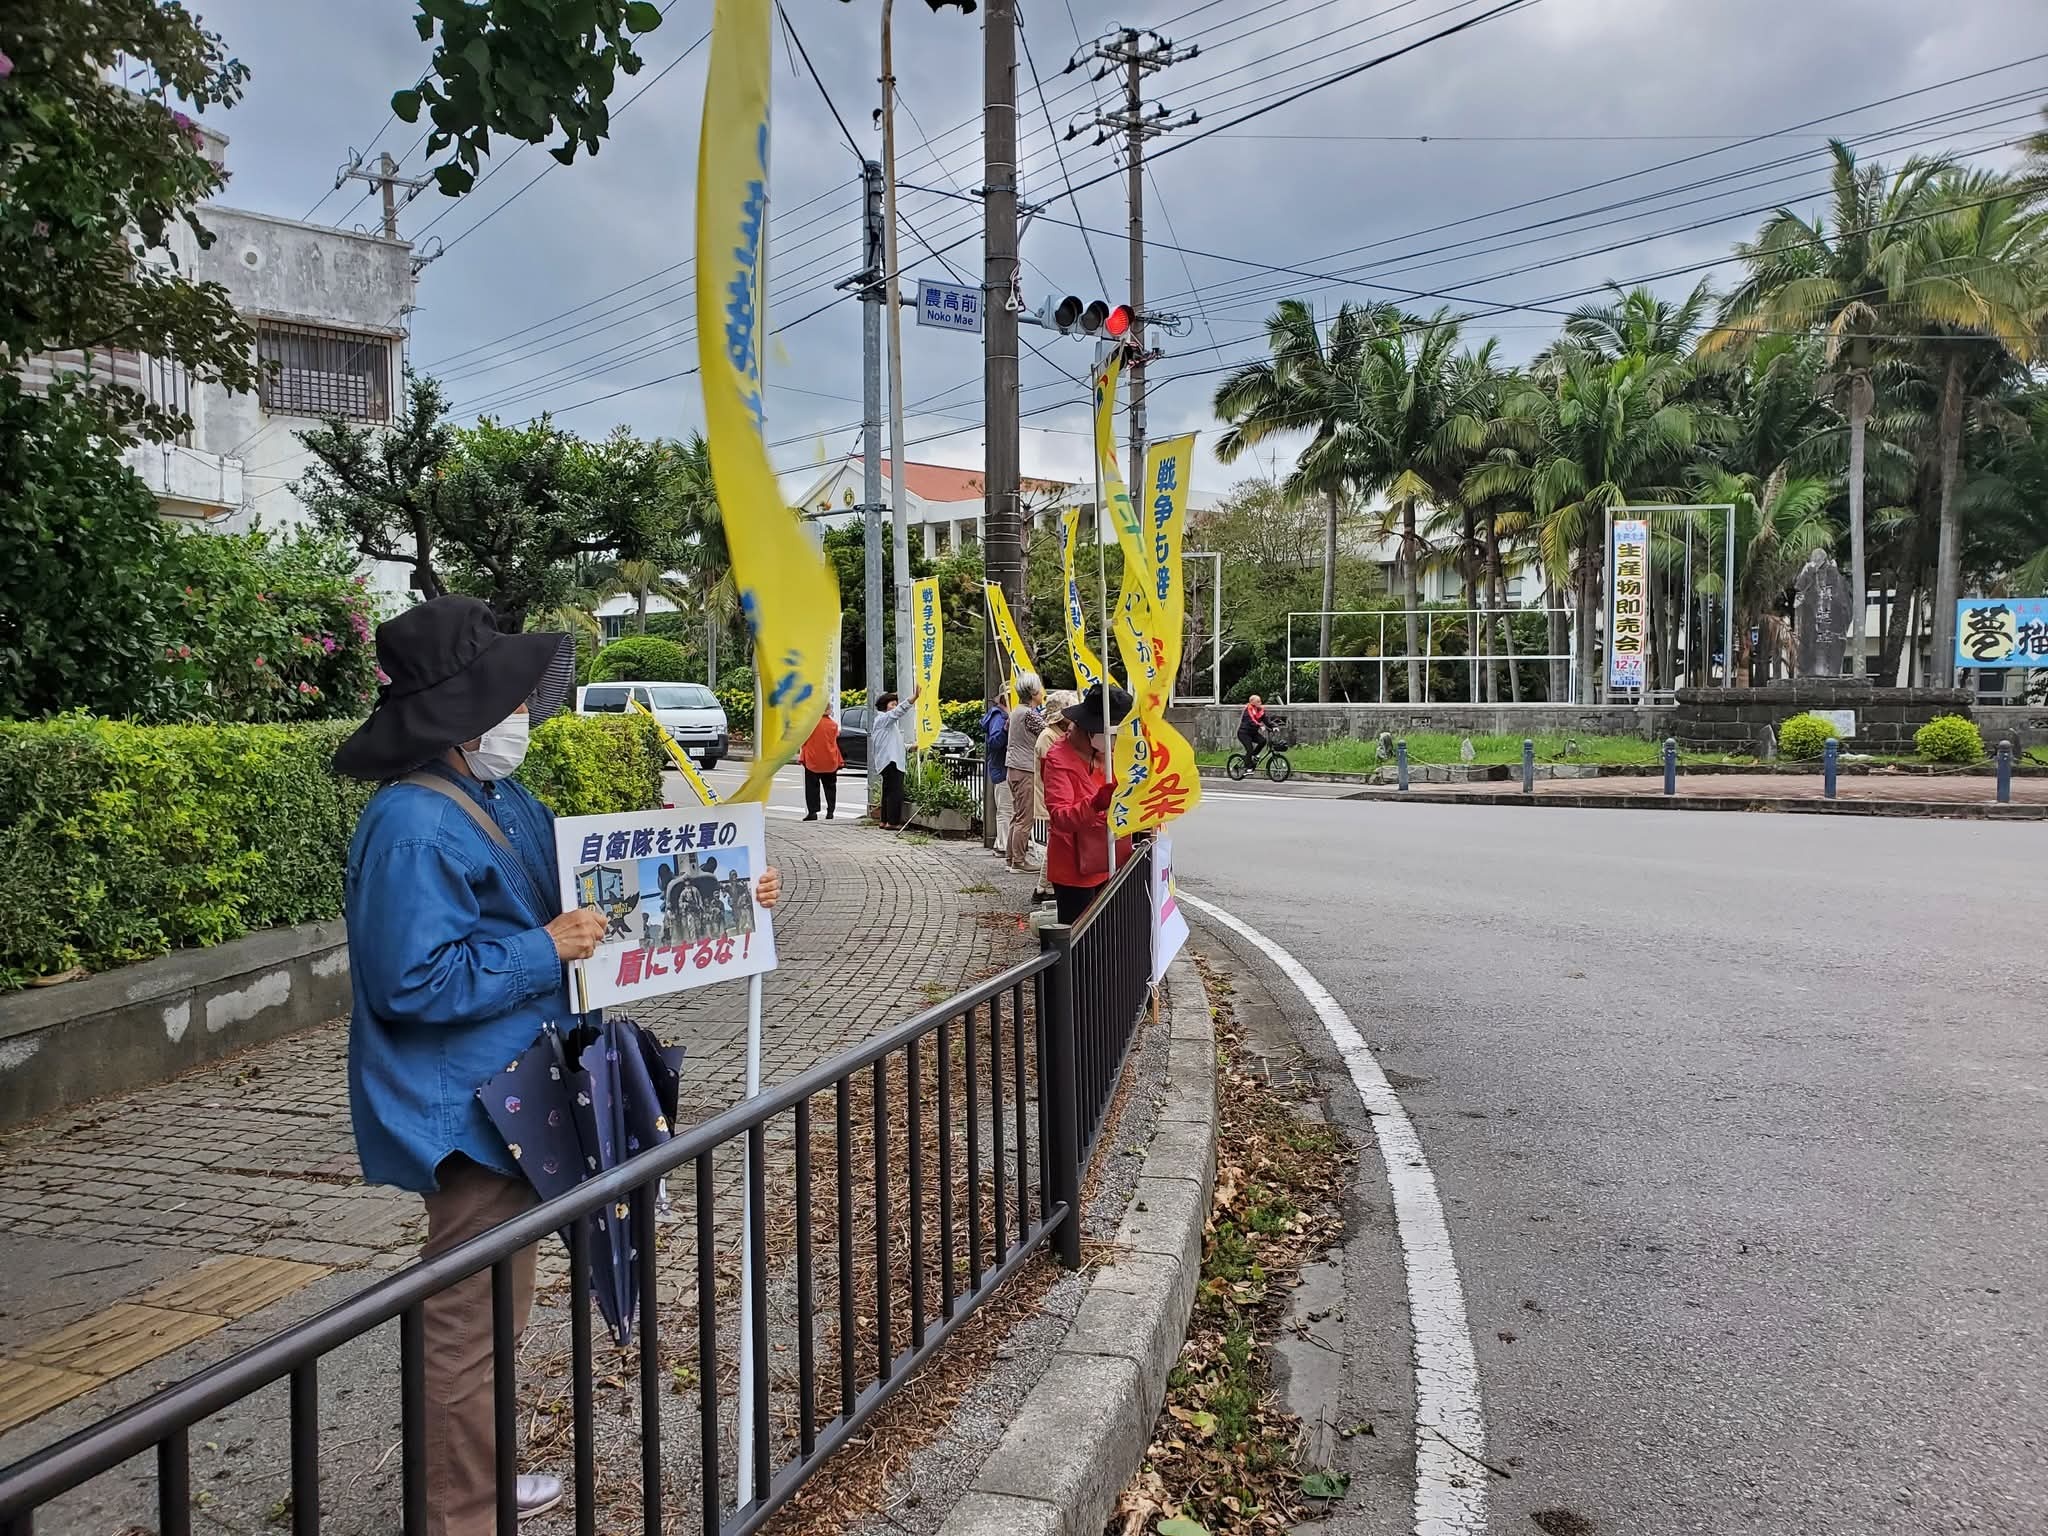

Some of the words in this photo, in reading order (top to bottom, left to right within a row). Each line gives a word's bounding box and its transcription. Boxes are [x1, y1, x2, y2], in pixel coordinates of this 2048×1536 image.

[926, 288, 977, 313] 農高前
[927, 309, 951, 322] Noko
[954, 313, 974, 326] Mae
[1615, 543, 1641, 652] 生産物即売会
[580, 821, 737, 865] 自衛隊を米軍の
